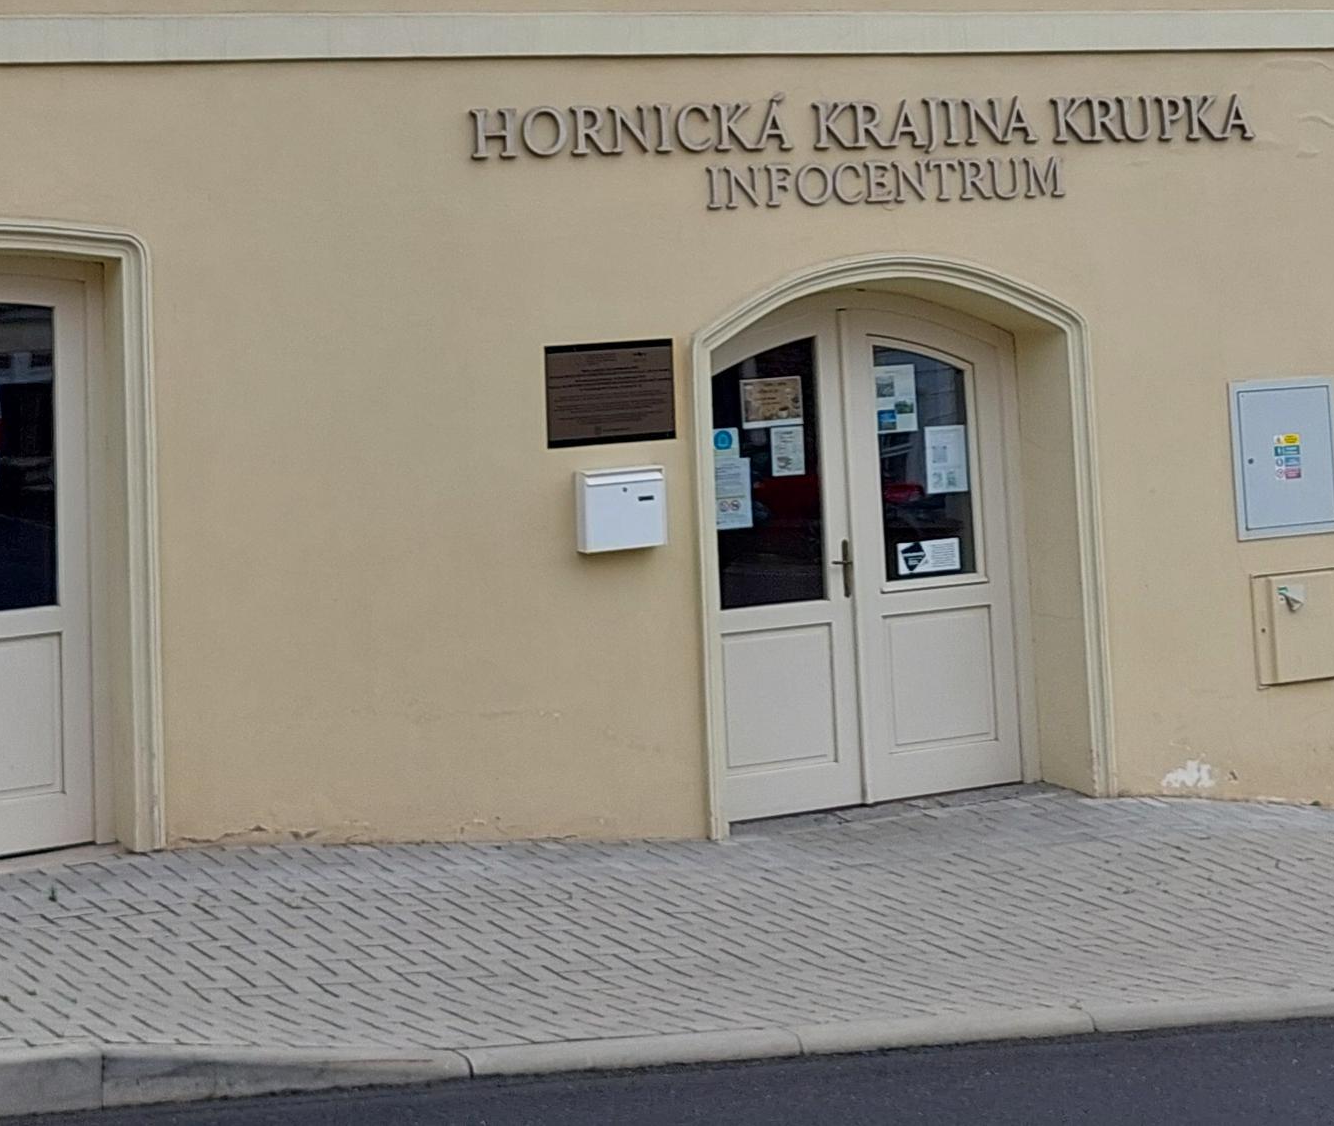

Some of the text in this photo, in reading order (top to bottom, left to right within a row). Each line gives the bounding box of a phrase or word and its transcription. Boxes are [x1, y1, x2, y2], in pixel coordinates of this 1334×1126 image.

[468, 91, 1255, 160] HORNICKÁ KRAJINA KRUPKA
[704, 154, 1067, 210] INFOCENTRUM
